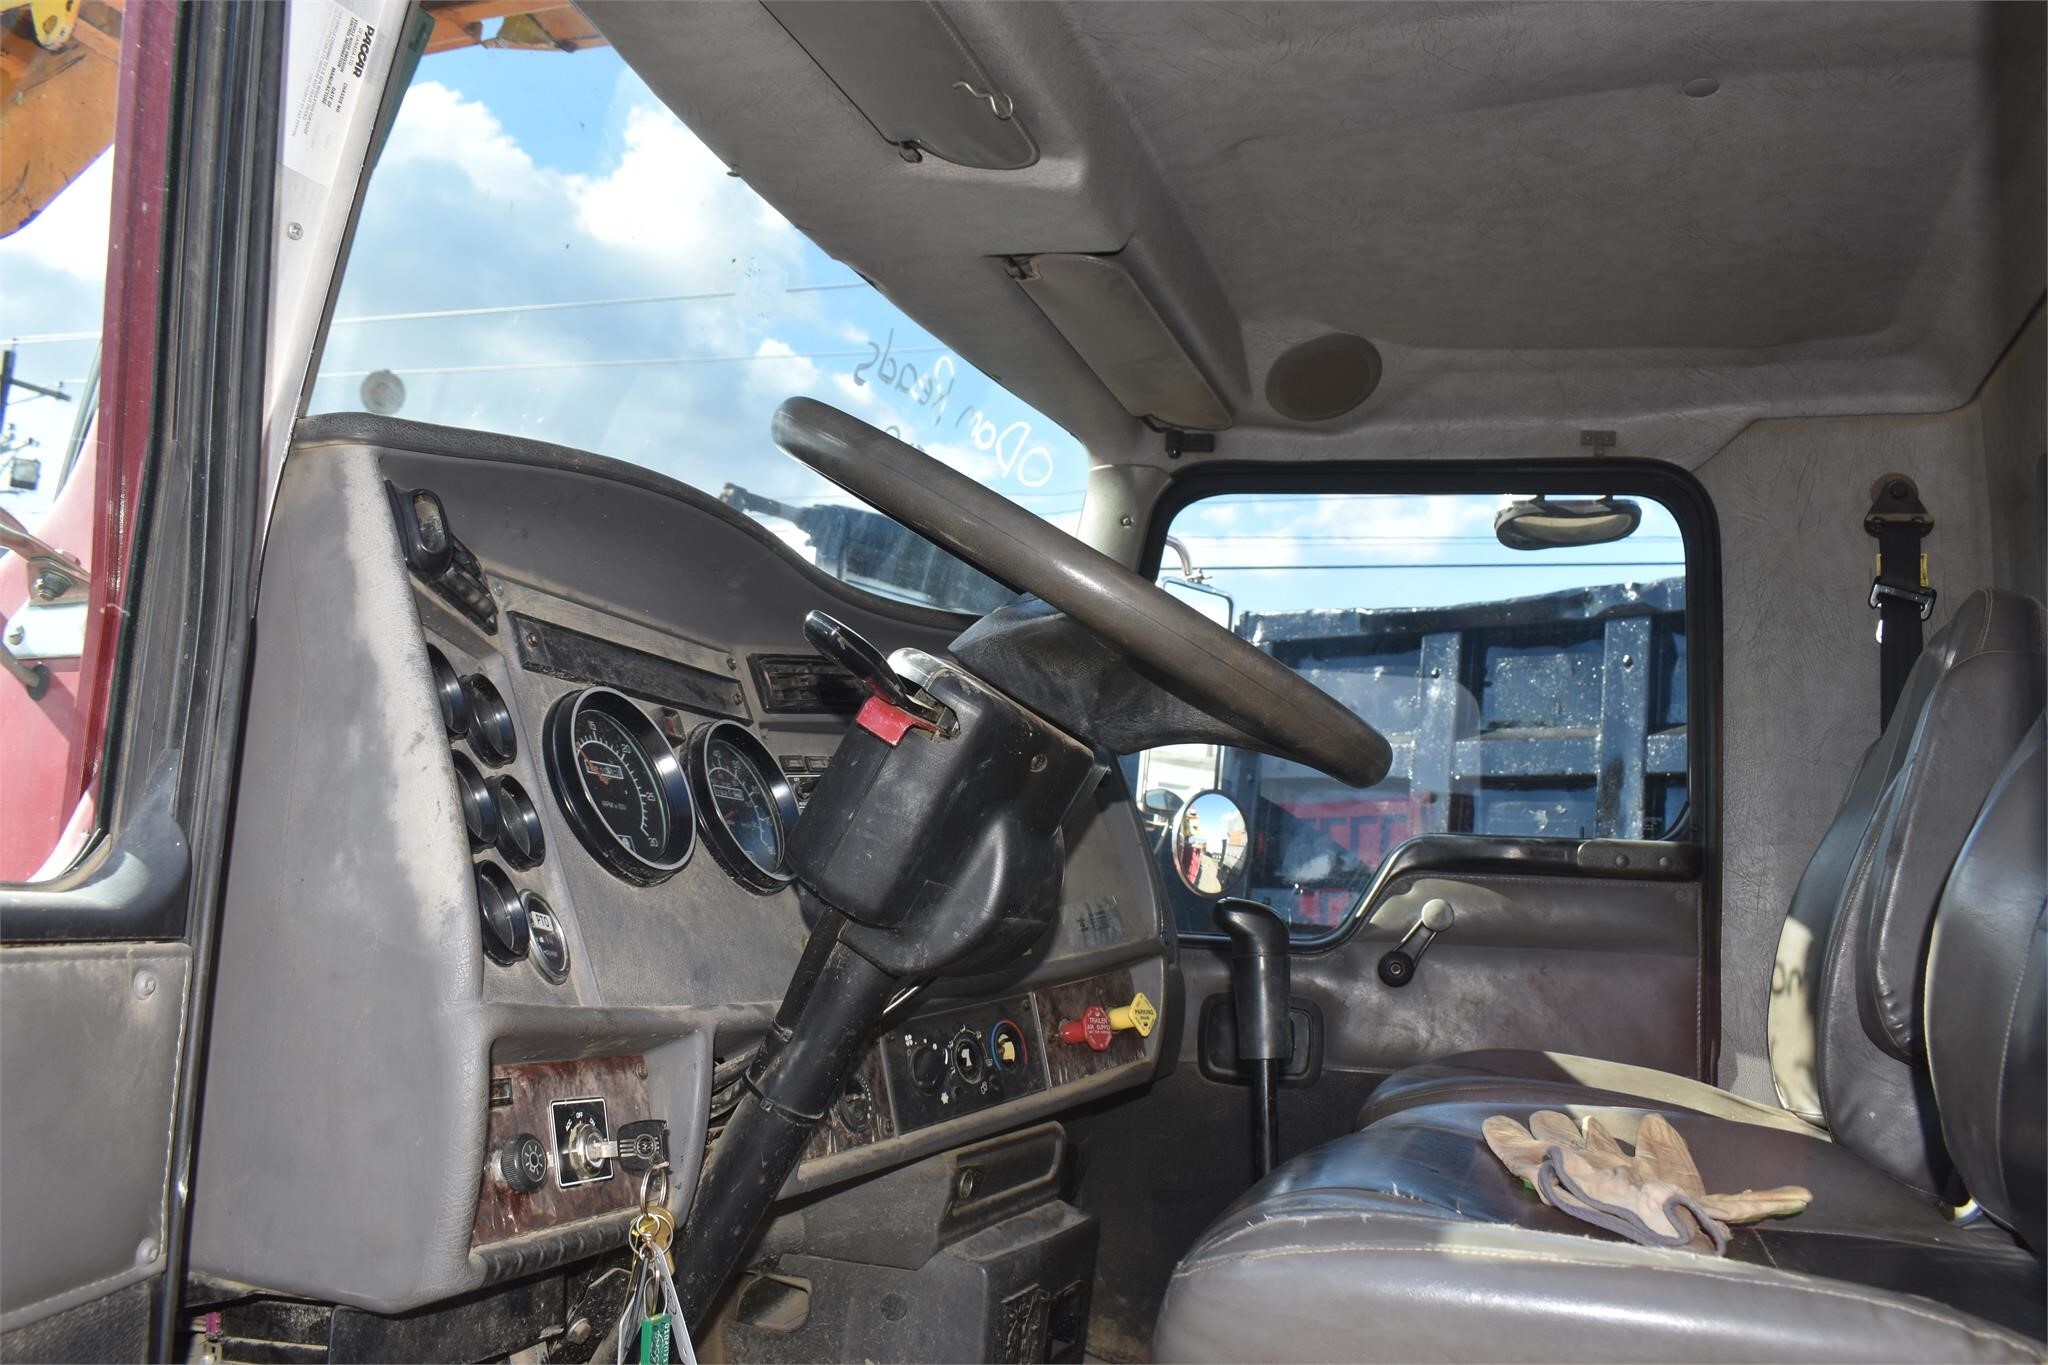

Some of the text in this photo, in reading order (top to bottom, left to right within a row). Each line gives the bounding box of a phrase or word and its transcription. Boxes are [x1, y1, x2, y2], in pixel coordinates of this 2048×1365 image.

[353, 25, 375, 78] PACCAR
[322, 67, 336, 105] MANUFACTURE
[338, 83, 348, 104] CHASSIS
[535, 913, 550, 928] PTO
[1088, 1017, 1108, 1025] TRAILER
[575, 1111, 584, 1119] OFF
[589, 1117, 596, 1127] ON
